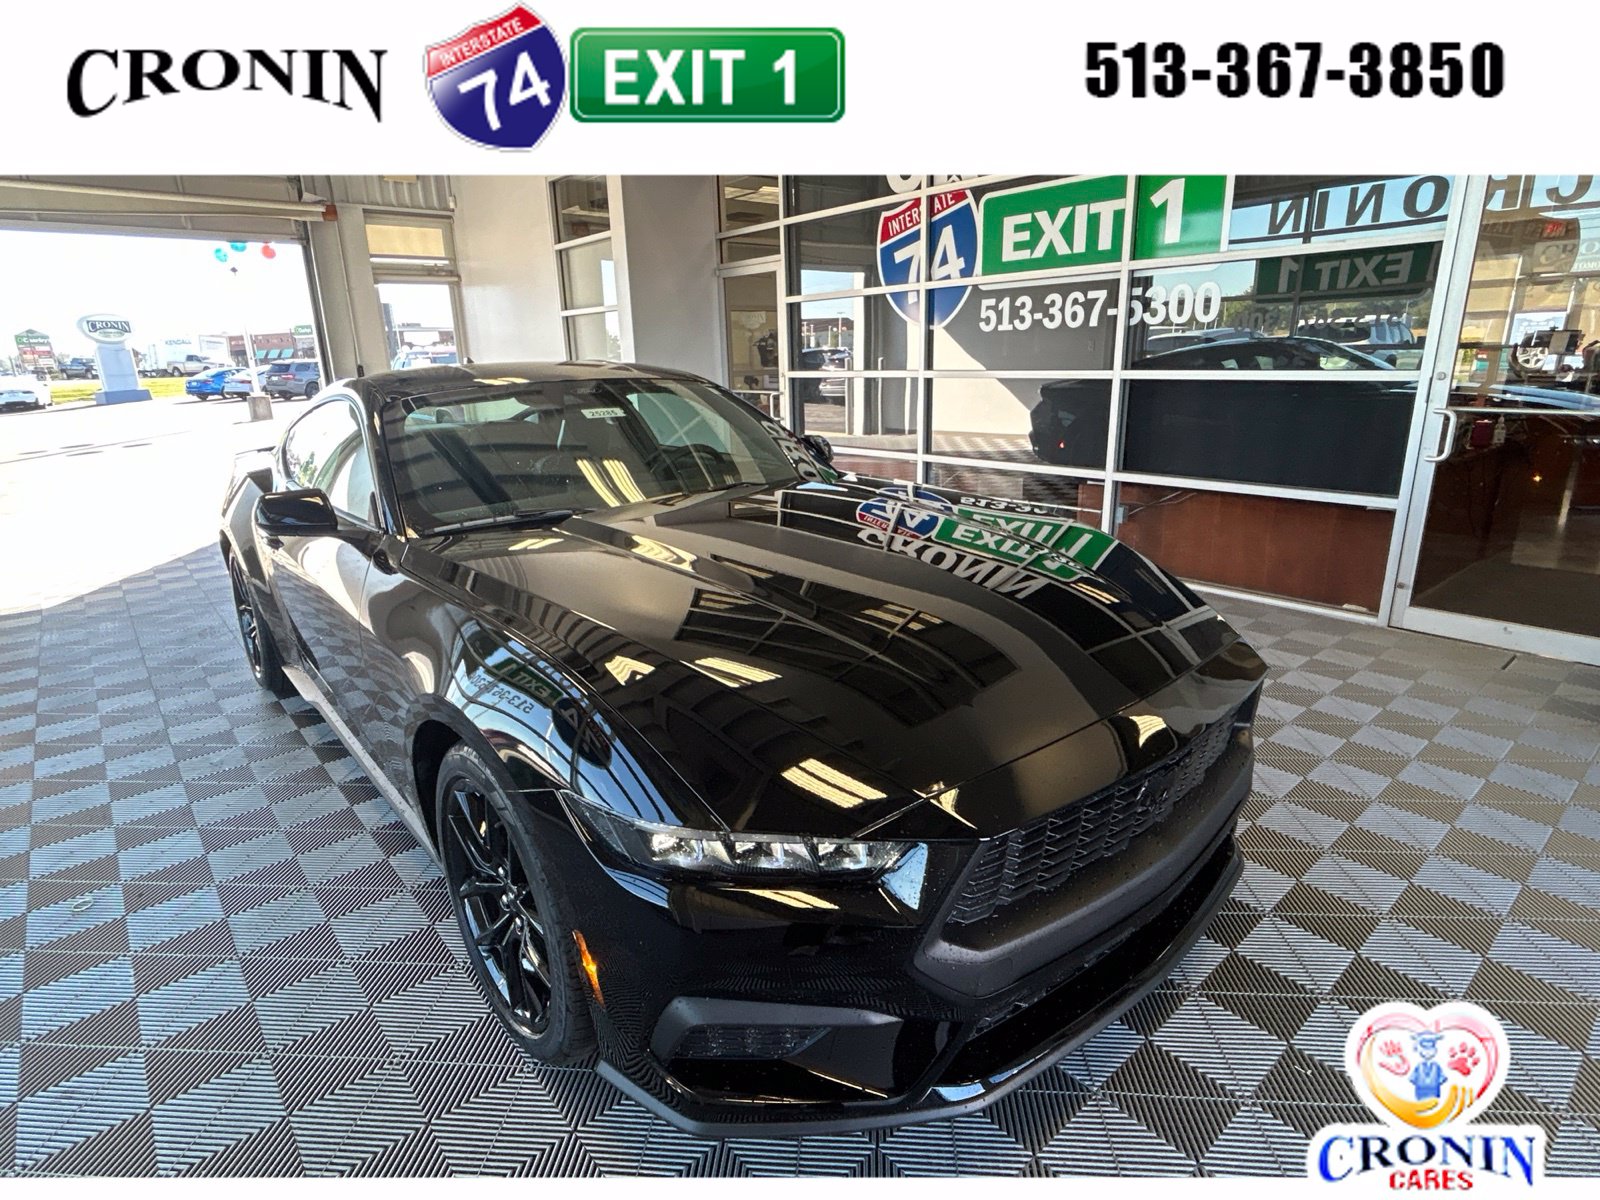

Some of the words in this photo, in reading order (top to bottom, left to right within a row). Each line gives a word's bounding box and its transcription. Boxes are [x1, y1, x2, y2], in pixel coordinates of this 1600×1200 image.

[1001, 198, 1126, 263] EXIT
[1149, 177, 1187, 245] 1
[893, 224, 966, 305] 74
[88, 320, 131, 333] CRONIN
[978, 280, 1223, 333] 513-367-5300
